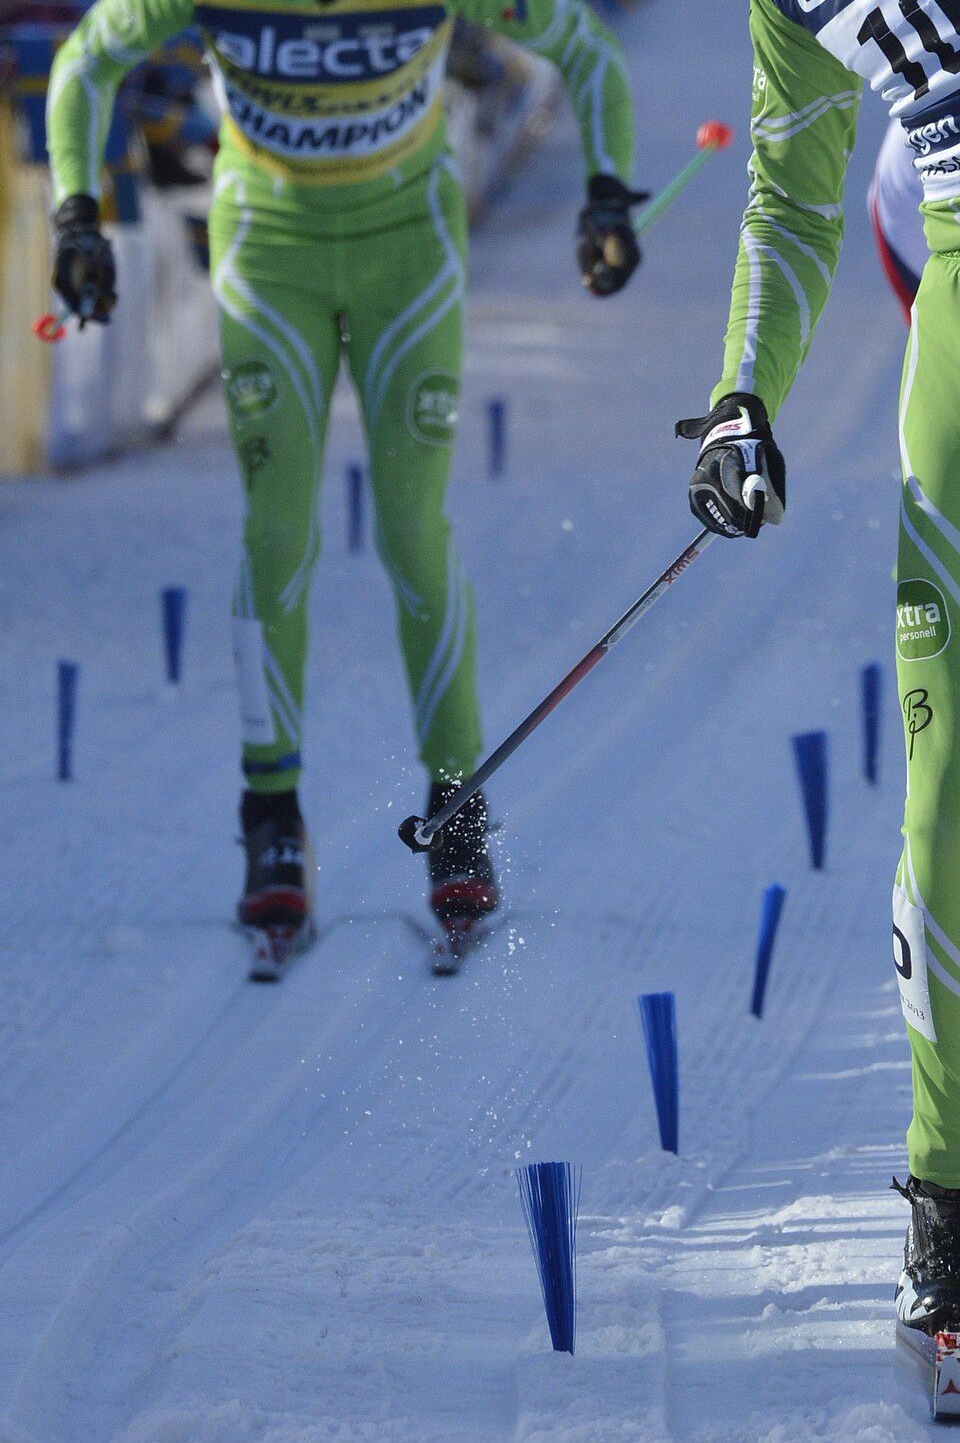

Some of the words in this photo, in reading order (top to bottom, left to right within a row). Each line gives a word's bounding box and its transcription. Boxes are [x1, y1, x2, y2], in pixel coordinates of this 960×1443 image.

[213, 25, 435, 78] alecta
[896, 601, 941, 629] xtra
[899, 625, 937, 644] personell
